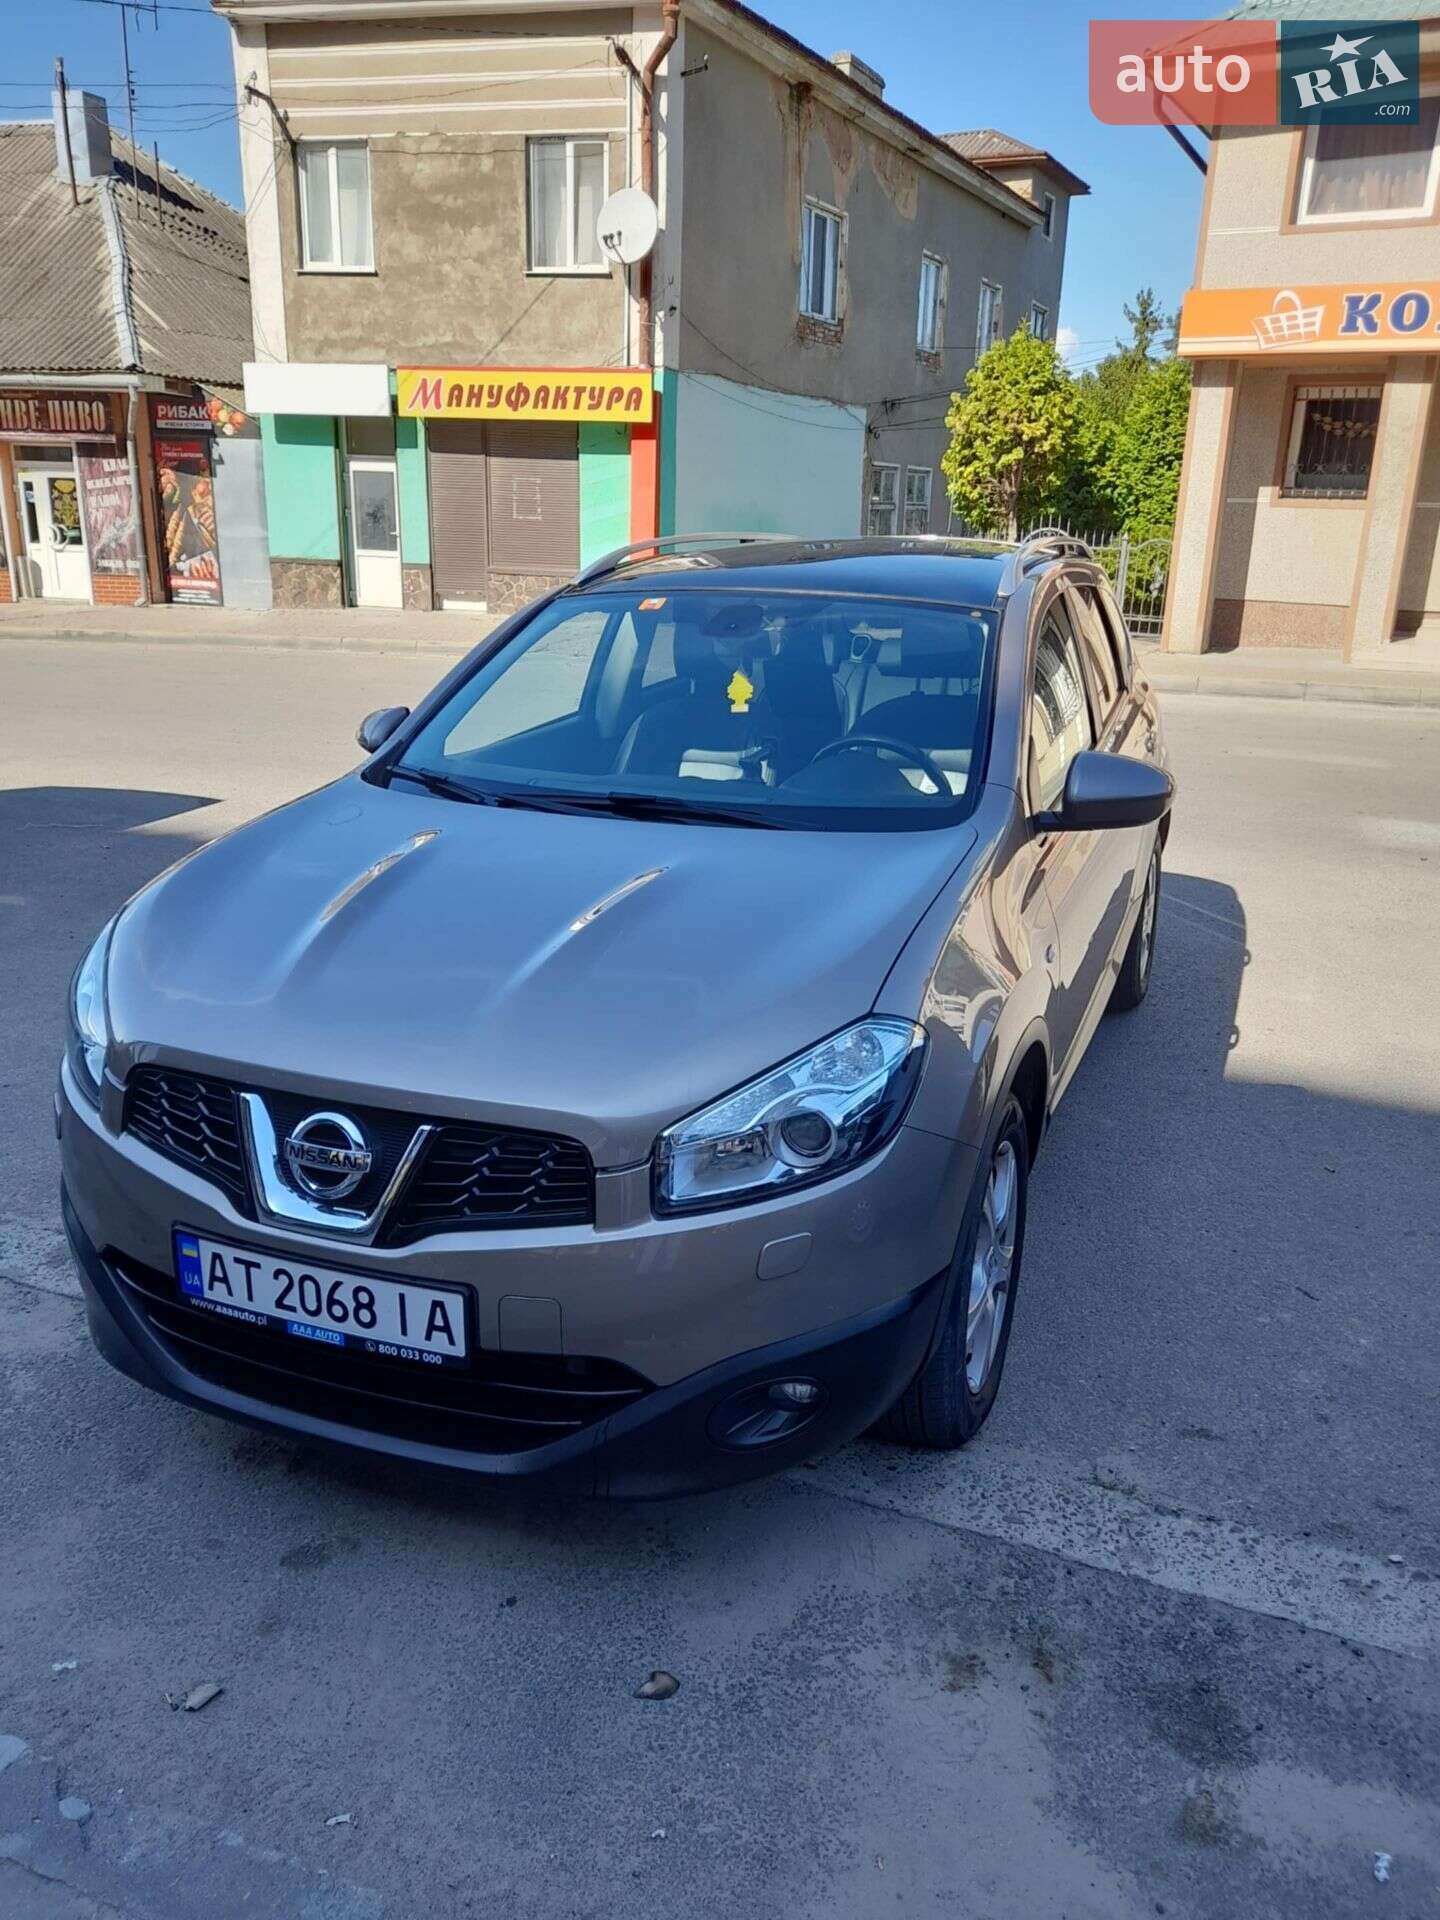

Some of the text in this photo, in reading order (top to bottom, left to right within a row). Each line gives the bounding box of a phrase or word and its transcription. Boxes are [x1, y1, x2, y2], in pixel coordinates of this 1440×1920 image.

[47, 400, 106, 432] ПИВО
[157, 404, 209, 419] РИБАК
[289, 1143, 358, 1169] NISSAN
[183, 1271, 201, 1287] UA
[207, 1251, 457, 1347] AT 2068 IA
[189, 1297, 269, 1327] www.aaaauto.pl
[292, 1323, 341, 1343] AAA AUTO
[378, 1344, 444, 1366] 800 033 000
